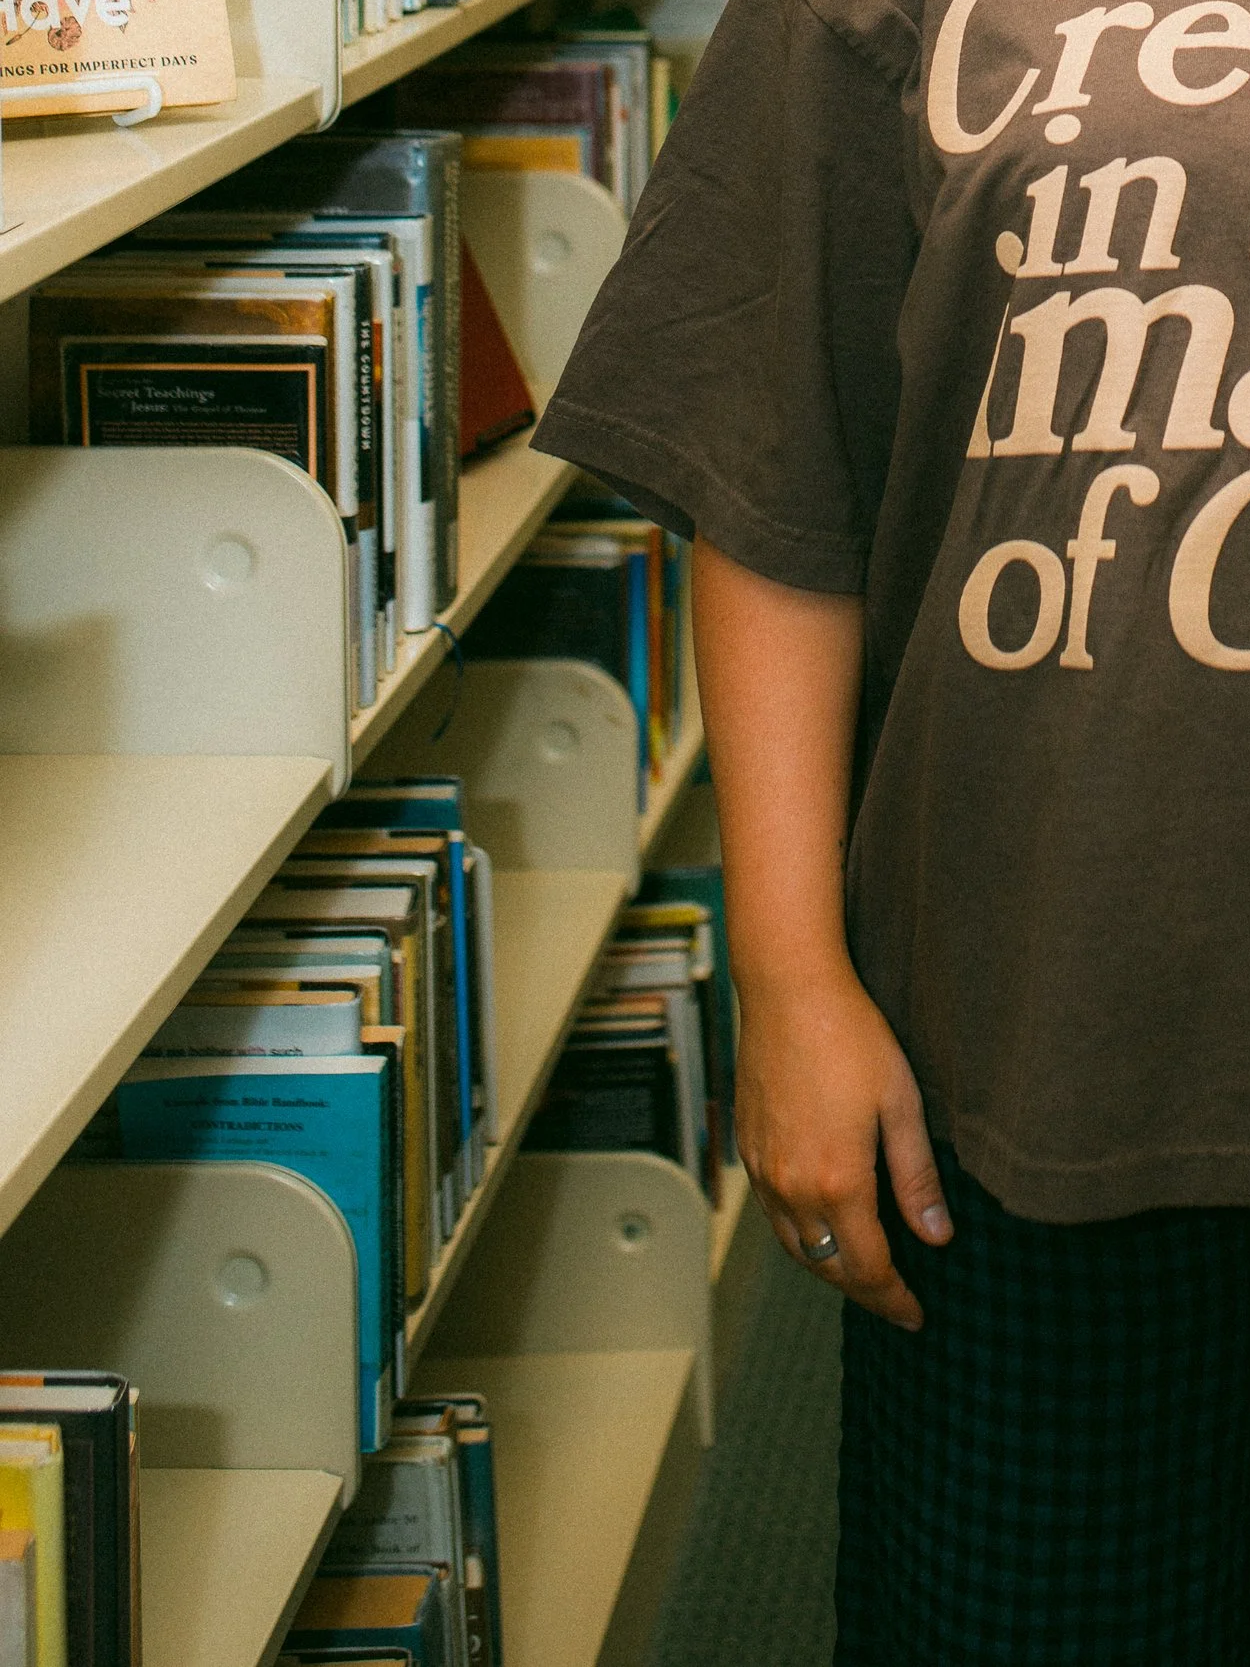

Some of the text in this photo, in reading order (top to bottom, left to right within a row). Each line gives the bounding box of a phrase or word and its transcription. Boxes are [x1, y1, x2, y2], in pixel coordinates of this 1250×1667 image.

[40, 54, 199, 75] FOR IMPERFECT DAYS
[1014, 107, 1188, 279] in
[143, 386, 216, 404] Teachings
[360, 320, 372, 452] THE COUNTDOWN
[957, 462, 1160, 670] of
